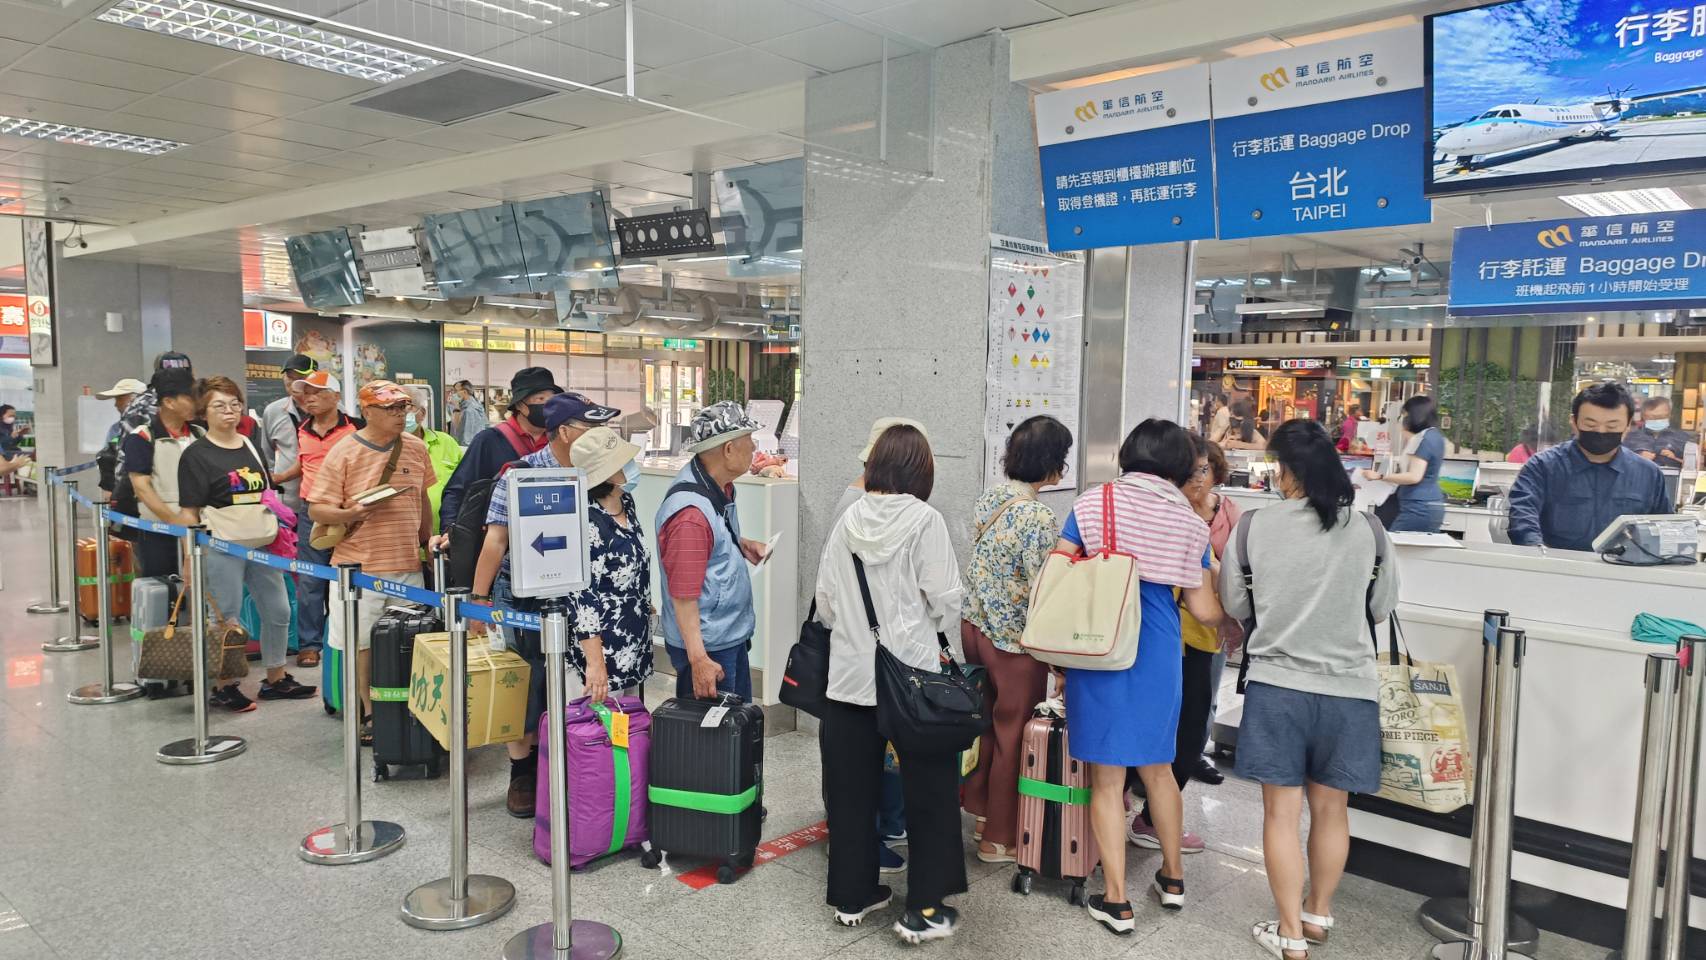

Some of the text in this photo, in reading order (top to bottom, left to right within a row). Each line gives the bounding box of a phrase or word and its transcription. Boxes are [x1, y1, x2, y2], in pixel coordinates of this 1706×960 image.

[1295, 53, 1374, 78] 華信航空
[1655, 48, 1704, 64] Baggage
[1103, 90, 1164, 110] 華信航空
[1232, 122, 1411, 158] 行李託運 Baggage Drop
[1289, 166, 1349, 201] 台北
[1292, 203, 1347, 222] TAIPEI
[1580, 220, 1675, 238] 華信航空
[1479, 256, 1567, 280] 行李託運
[1579, 255, 1676, 275] Baggage
[534, 492, 560, 505] 出口
[1413, 681, 1448, 693] SANJI
[1404, 731, 1439, 742] PIECE
